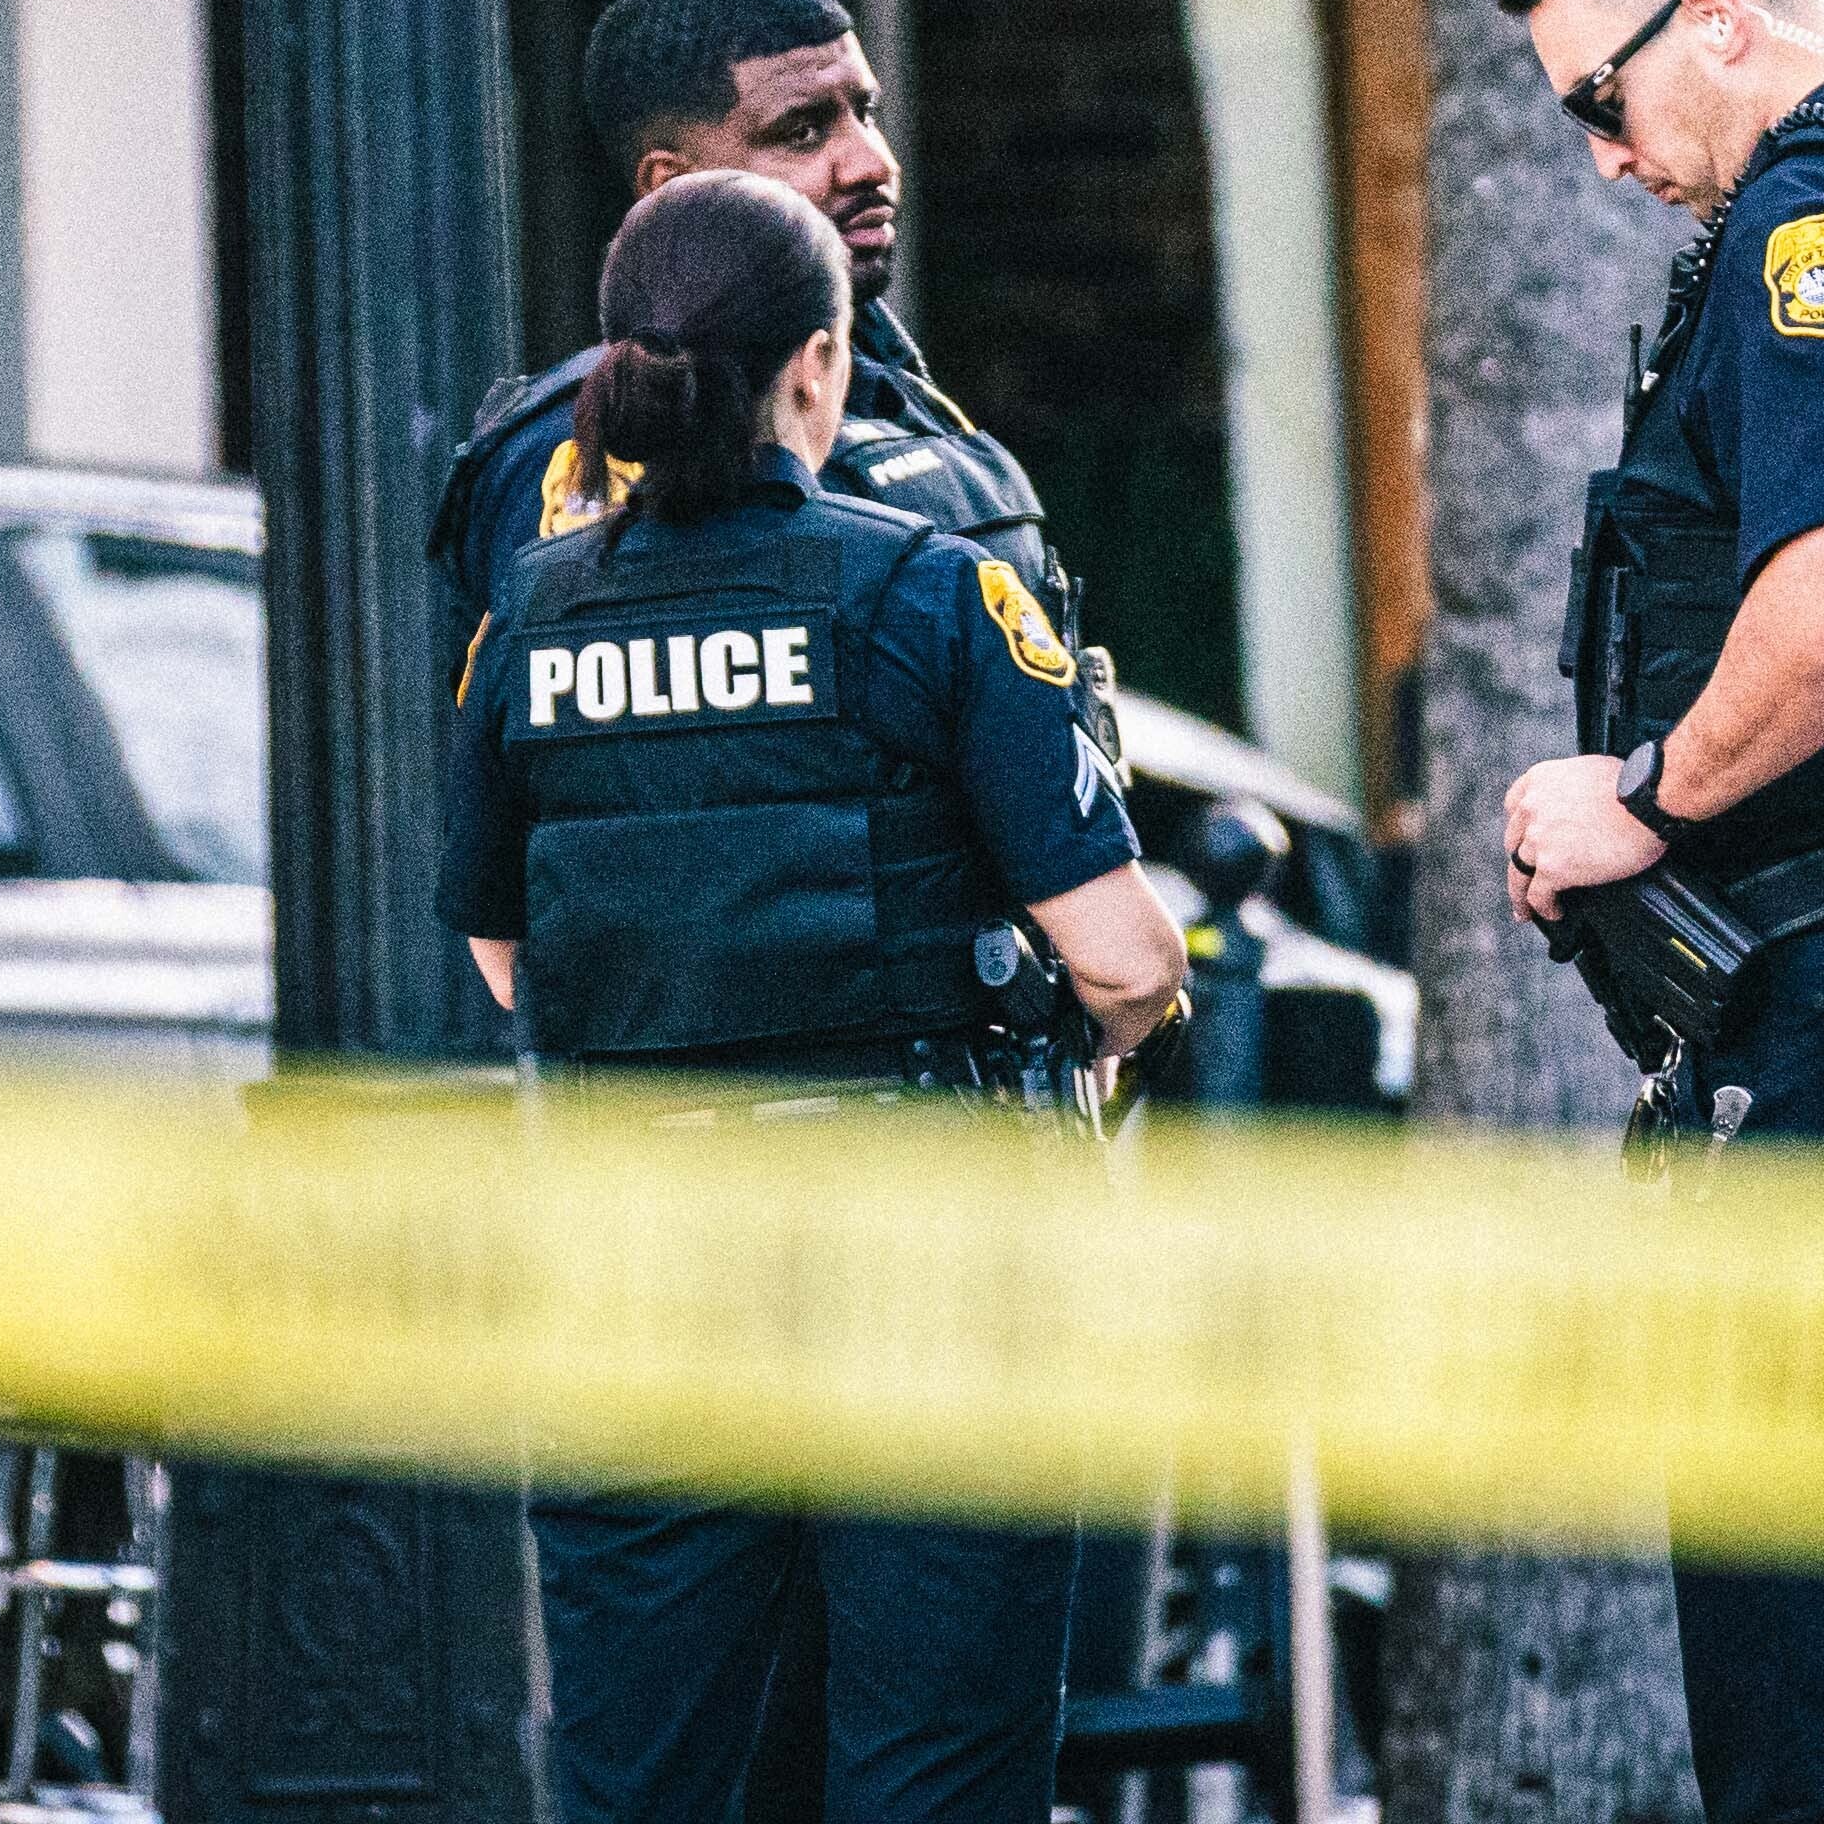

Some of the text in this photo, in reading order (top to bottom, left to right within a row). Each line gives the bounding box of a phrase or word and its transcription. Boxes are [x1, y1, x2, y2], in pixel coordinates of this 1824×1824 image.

[1782, 263, 1800, 283] CITY
[1801, 251, 1814, 264] OF
[529, 626, 814, 727] POLICE
